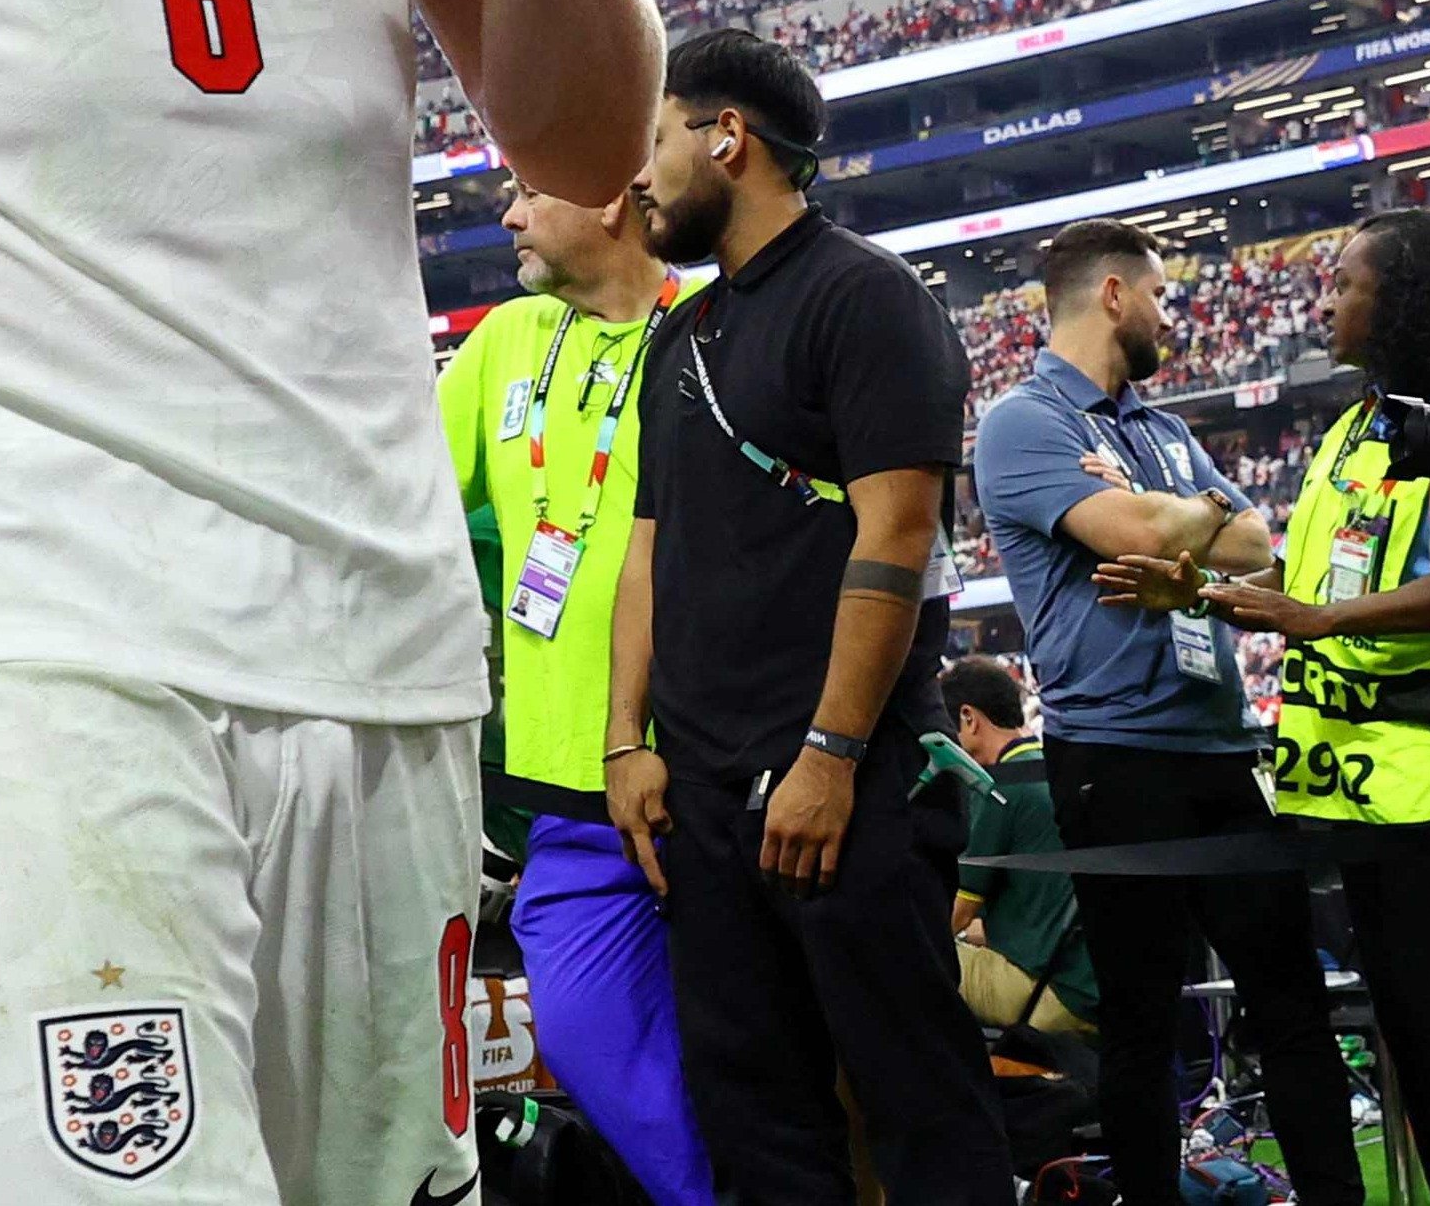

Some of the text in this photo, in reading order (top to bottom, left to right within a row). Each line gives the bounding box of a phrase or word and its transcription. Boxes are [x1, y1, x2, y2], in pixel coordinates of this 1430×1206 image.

[1356, 39, 1393, 61] FIFA
[983, 108, 1082, 144] DALLAS
[1275, 737, 1375, 805] 292
[438, 913, 471, 1138] 8
[482, 1044, 513, 1066] FIFA
[507, 1078, 537, 1093] CUP
